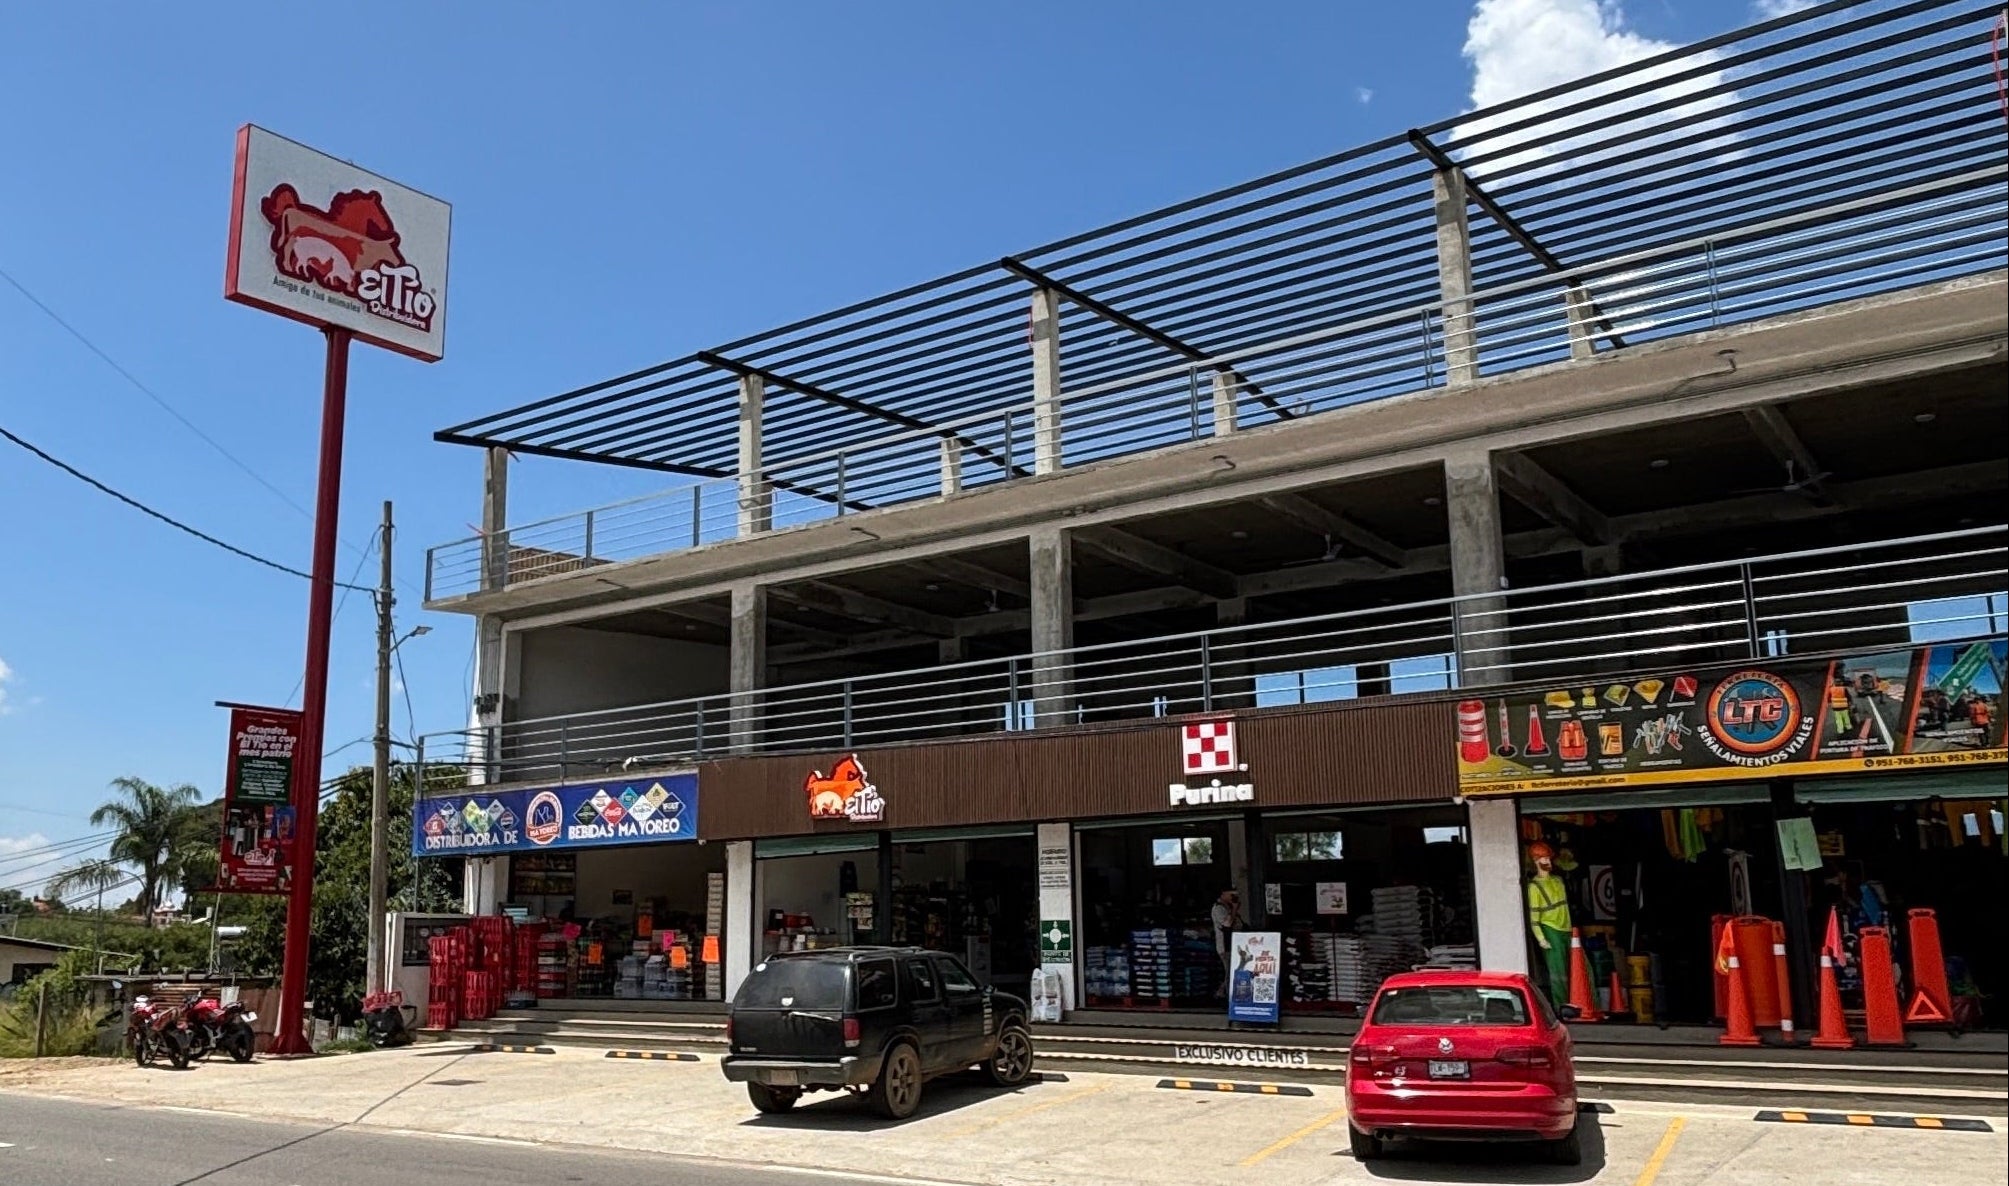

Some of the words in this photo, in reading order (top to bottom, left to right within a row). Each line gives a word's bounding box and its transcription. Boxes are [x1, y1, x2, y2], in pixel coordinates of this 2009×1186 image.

[273, 275, 298, 293] Amigo
[300, 285, 311, 296] de
[312, 289, 325, 301] tus
[327, 295, 361, 313] animales
[1722, 698, 1784, 725] LTC
[246, 725, 288, 736] Grandes
[1697, 725, 1788, 766] SEÑALAMIENTOS
[1785, 716, 1814, 754] VIALES
[261, 750, 293, 758] patrio
[1169, 779, 1254, 806] Purina
[425, 832, 500, 849] DISTRIBUIDORA
[503, 830, 518, 844] DE
[568, 823, 614, 839] BEBIDAS
[618, 818, 680, 837] MAYOREO
[1178, 1046, 1244, 1061] EXCLUSIVO
[1247, 1050, 1305, 1064] CLIENTES
